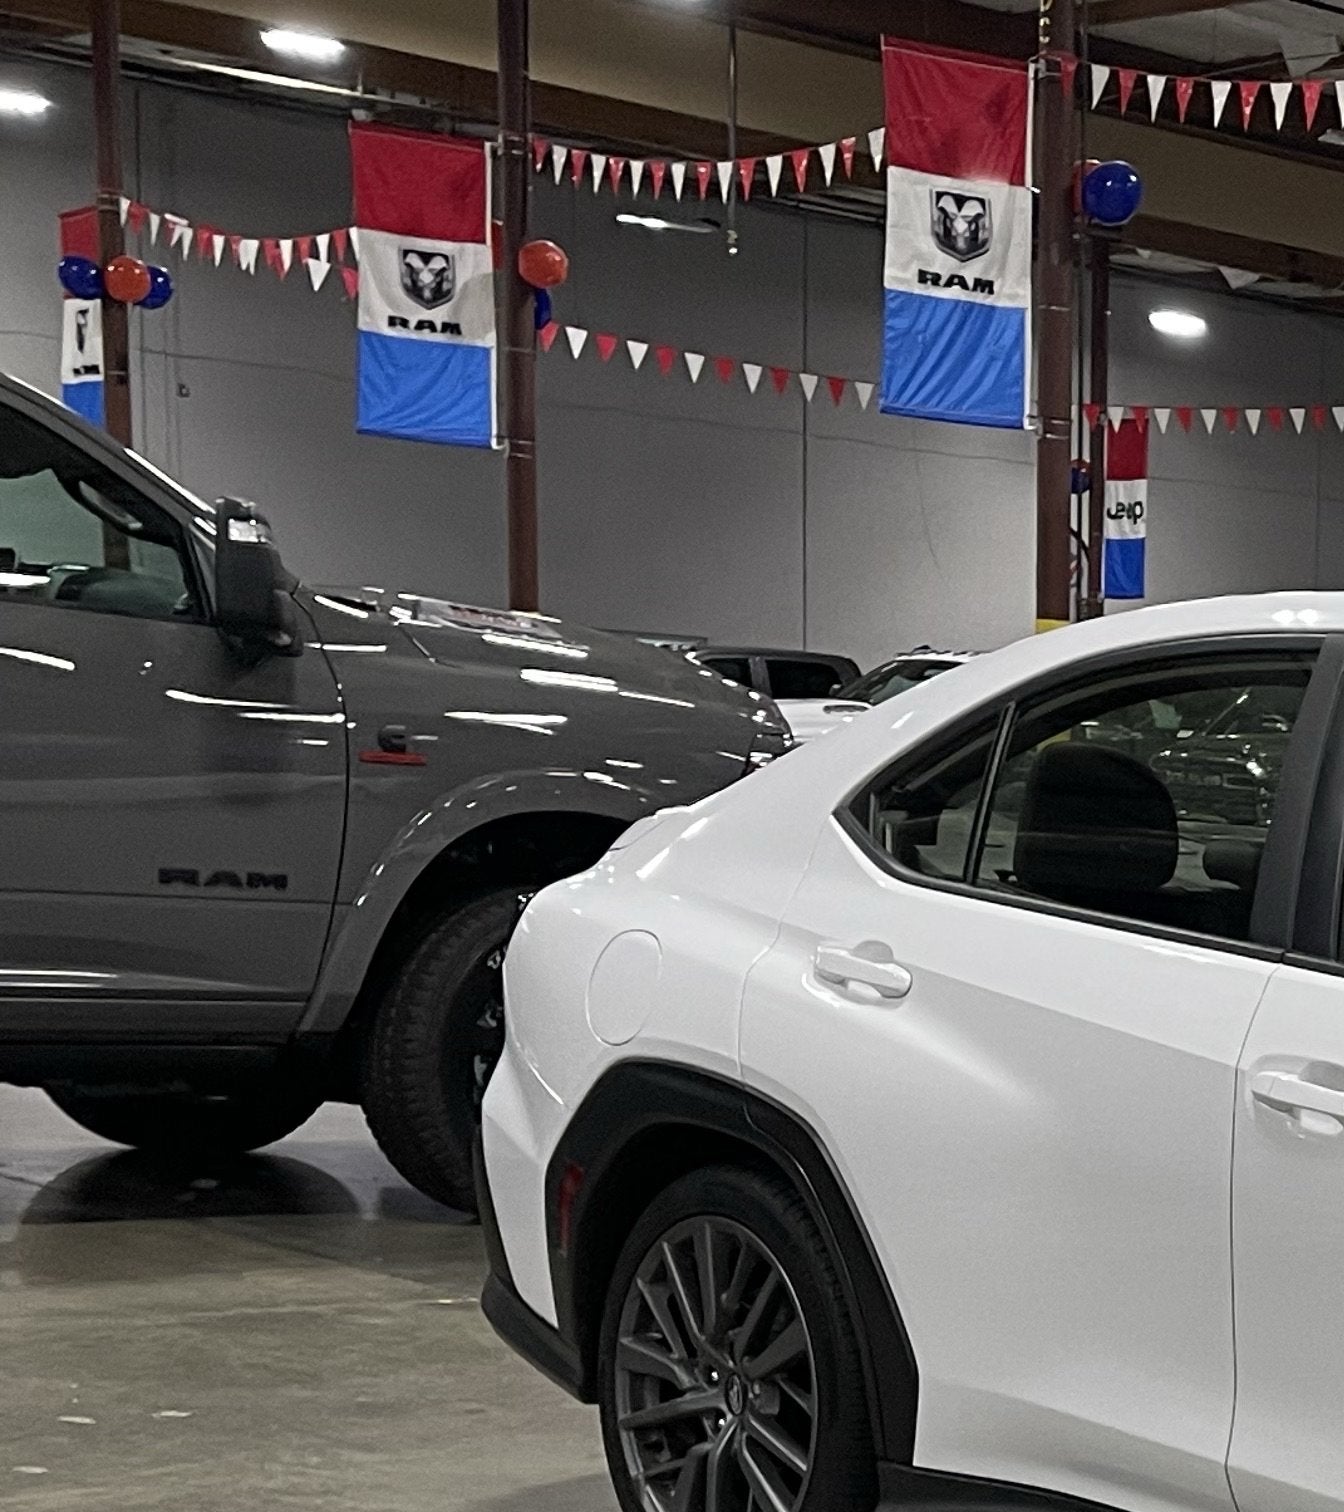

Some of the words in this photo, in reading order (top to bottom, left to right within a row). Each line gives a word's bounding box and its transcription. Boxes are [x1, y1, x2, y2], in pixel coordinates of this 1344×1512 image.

[917, 268, 995, 295] RAM
[388, 315, 462, 335] RAM
[158, 868, 288, 891] RAM
